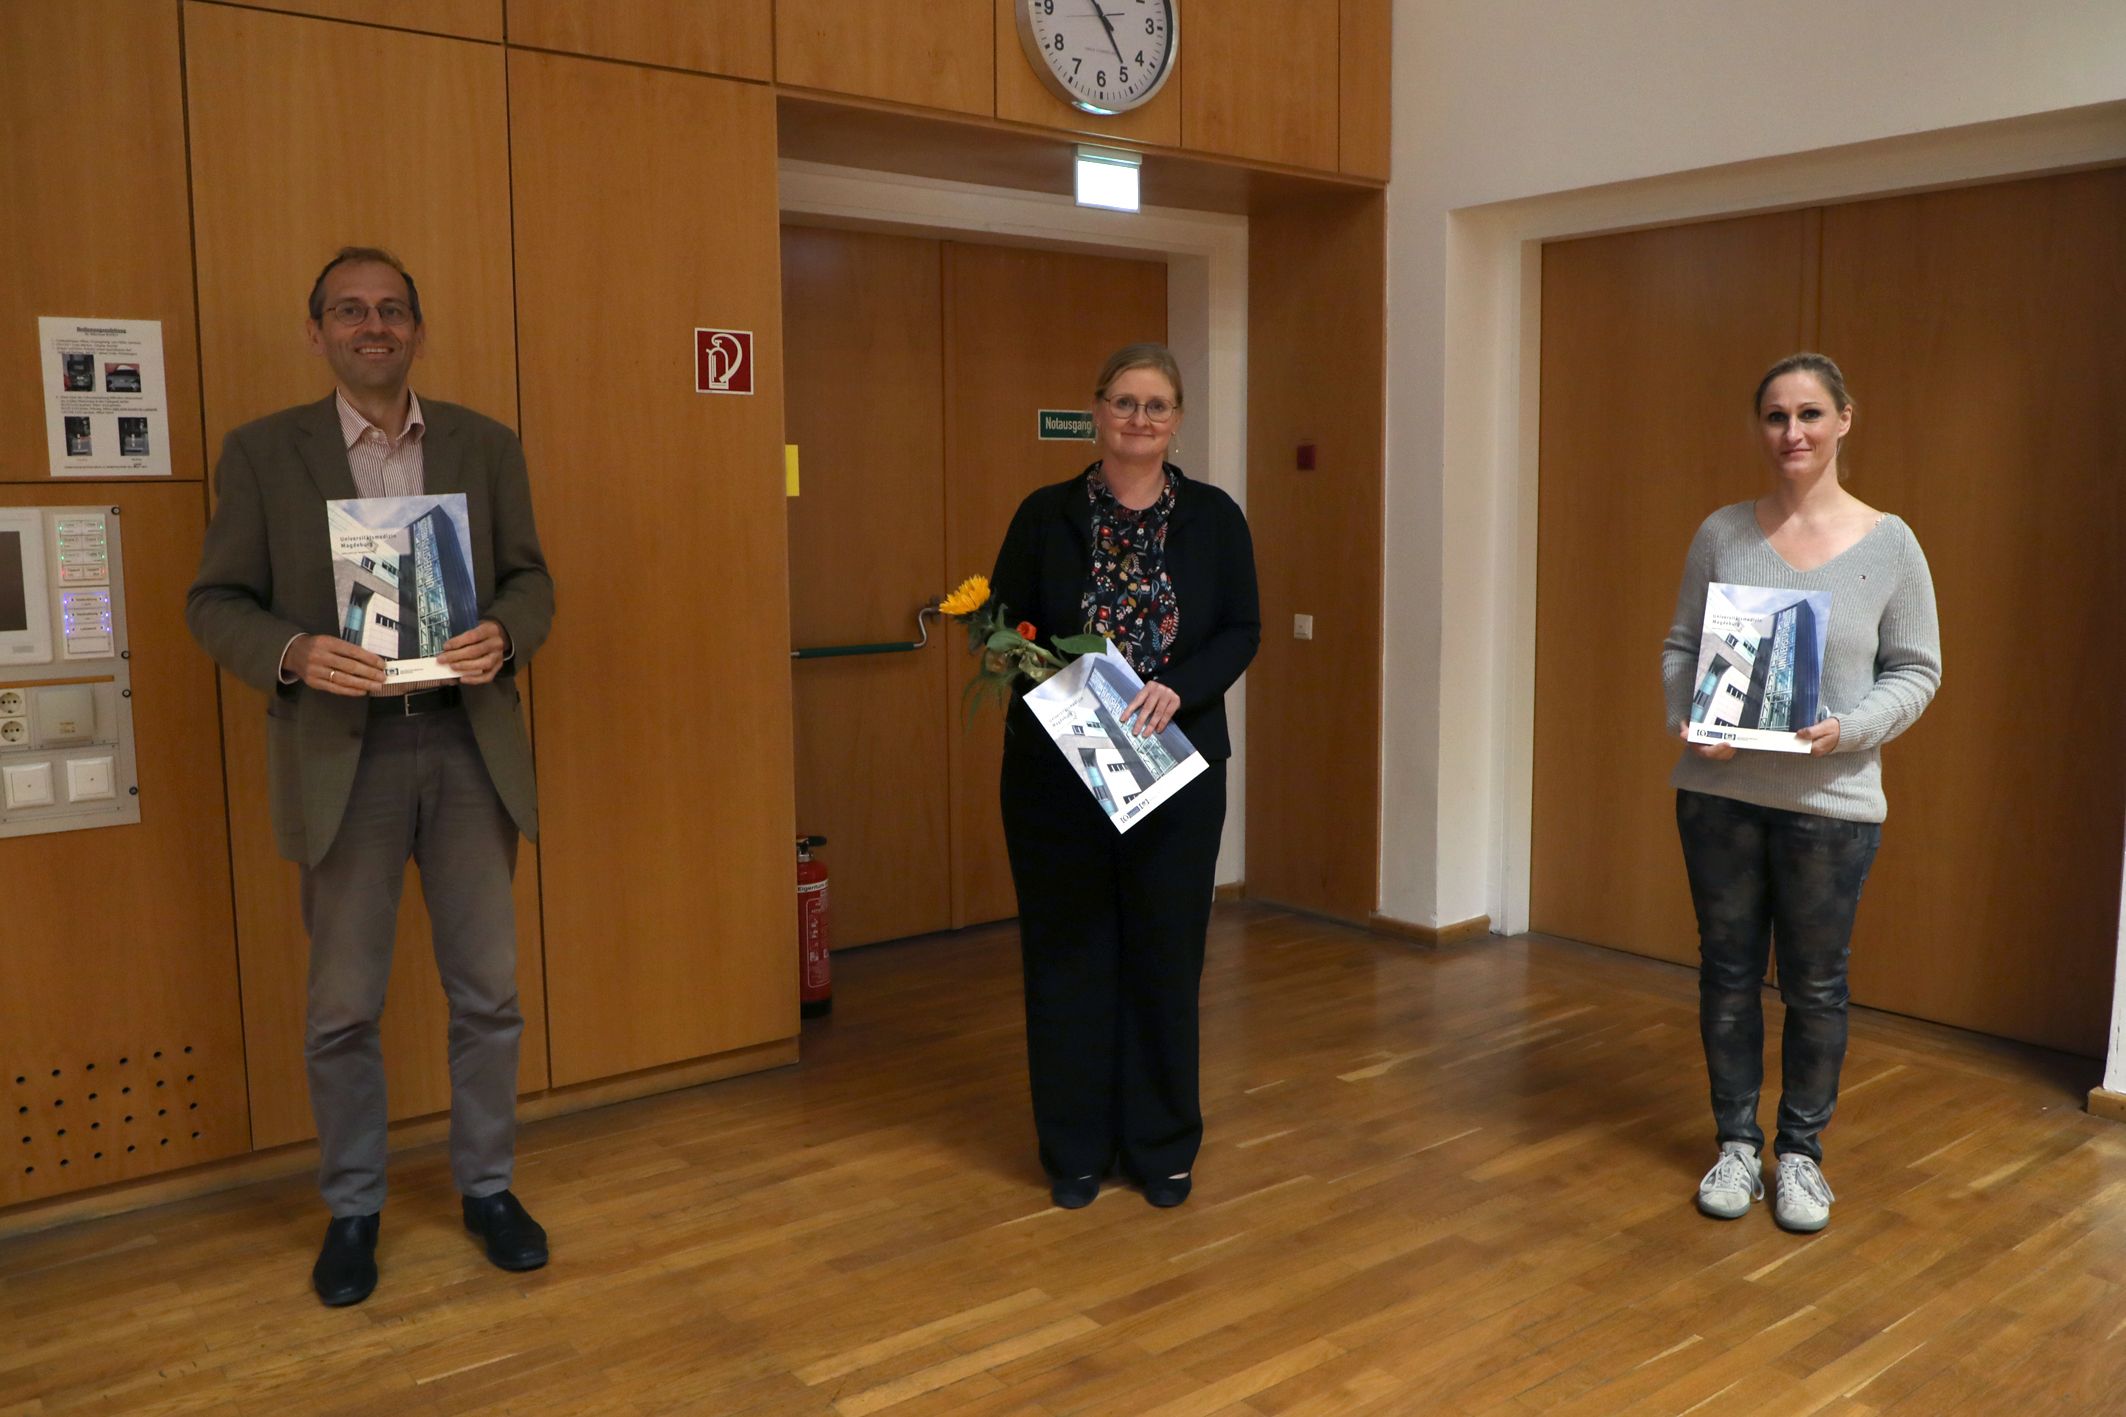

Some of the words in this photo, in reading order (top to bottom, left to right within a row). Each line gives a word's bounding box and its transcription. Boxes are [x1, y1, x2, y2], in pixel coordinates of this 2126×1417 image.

[1044, 0, 1054, 15] 9
[1145, 18, 1155, 35] 3
[1054, 33, 1064, 51] 8
[1072, 58, 1082, 74] 7
[1134, 50, 1144, 67] 4
[1096, 70, 1106, 87] 6
[1119, 66, 1129, 83] 5
[1045, 416, 1092, 434] Notausgang
[1712, 614, 1763, 623] Universitätsmedizin
[1712, 619, 1740, 627] Magdeburg
